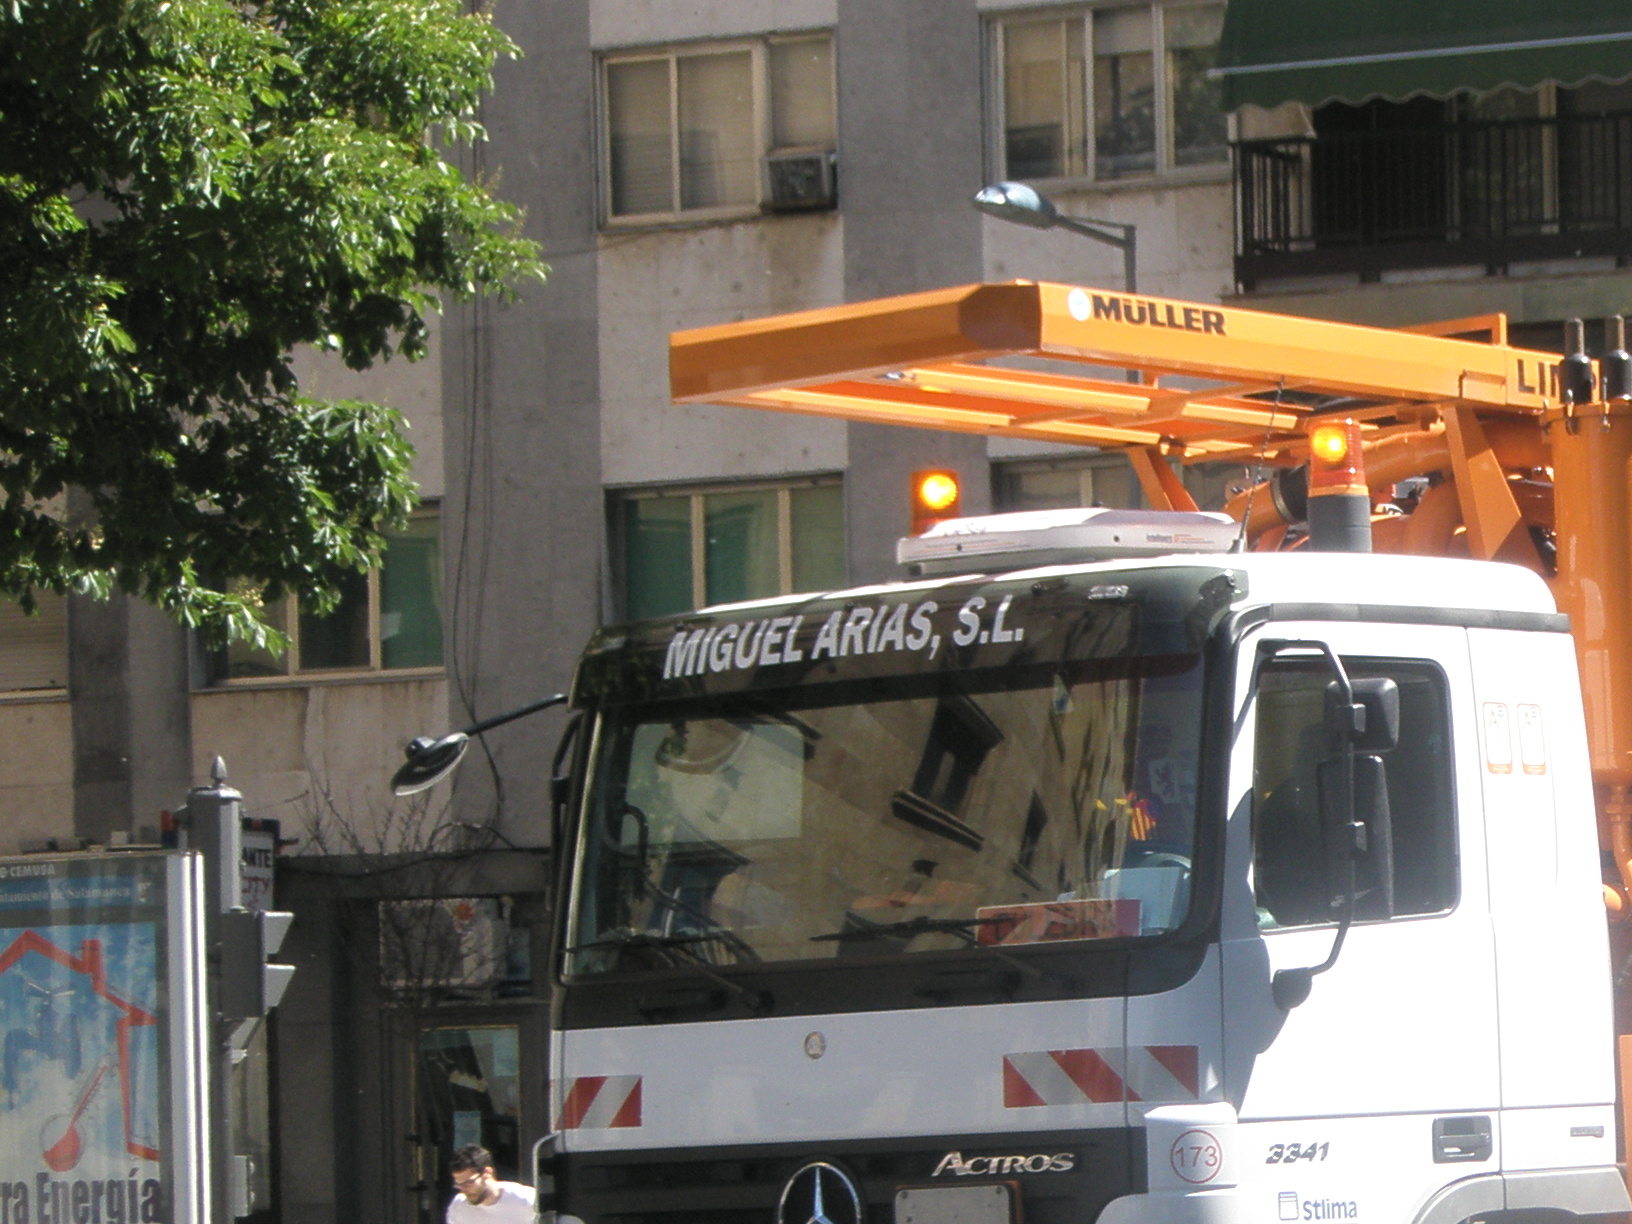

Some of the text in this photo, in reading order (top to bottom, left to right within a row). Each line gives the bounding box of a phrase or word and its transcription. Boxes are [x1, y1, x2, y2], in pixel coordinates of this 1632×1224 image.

[1092, 295, 1226, 336] MÜLLER
[663, 594, 1024, 679] MIGUEL ARIAS, S.L.
[1174, 1145, 1218, 1168] 173
[1265, 1142, 1330, 1164] 3341
[1303, 1199, 1357, 1220] Stlima
